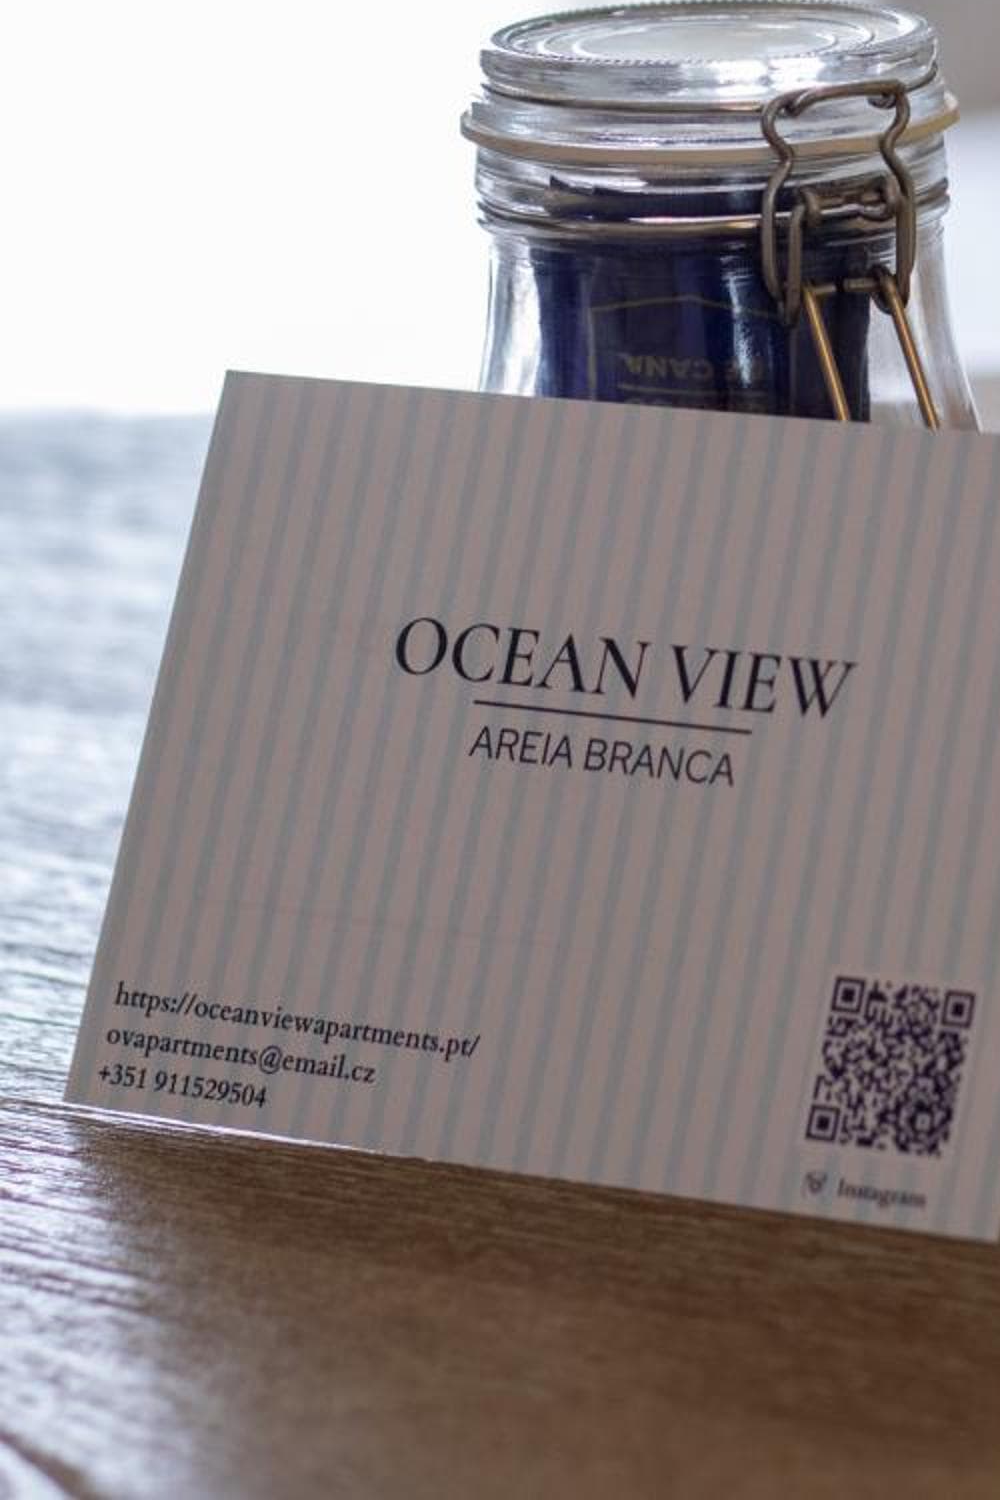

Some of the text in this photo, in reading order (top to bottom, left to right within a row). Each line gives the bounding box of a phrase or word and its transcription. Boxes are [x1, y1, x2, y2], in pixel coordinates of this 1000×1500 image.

[395, 617, 859, 719] OCEAN VIEW
[468, 725, 735, 787] AREIA BRANCA
[115, 981, 481, 1062] https://oceanviewapartments.pt/
[98, 1063, 267, 1108] +351 911529504
[106, 1027, 377, 1084] ovapartments@email.cz
